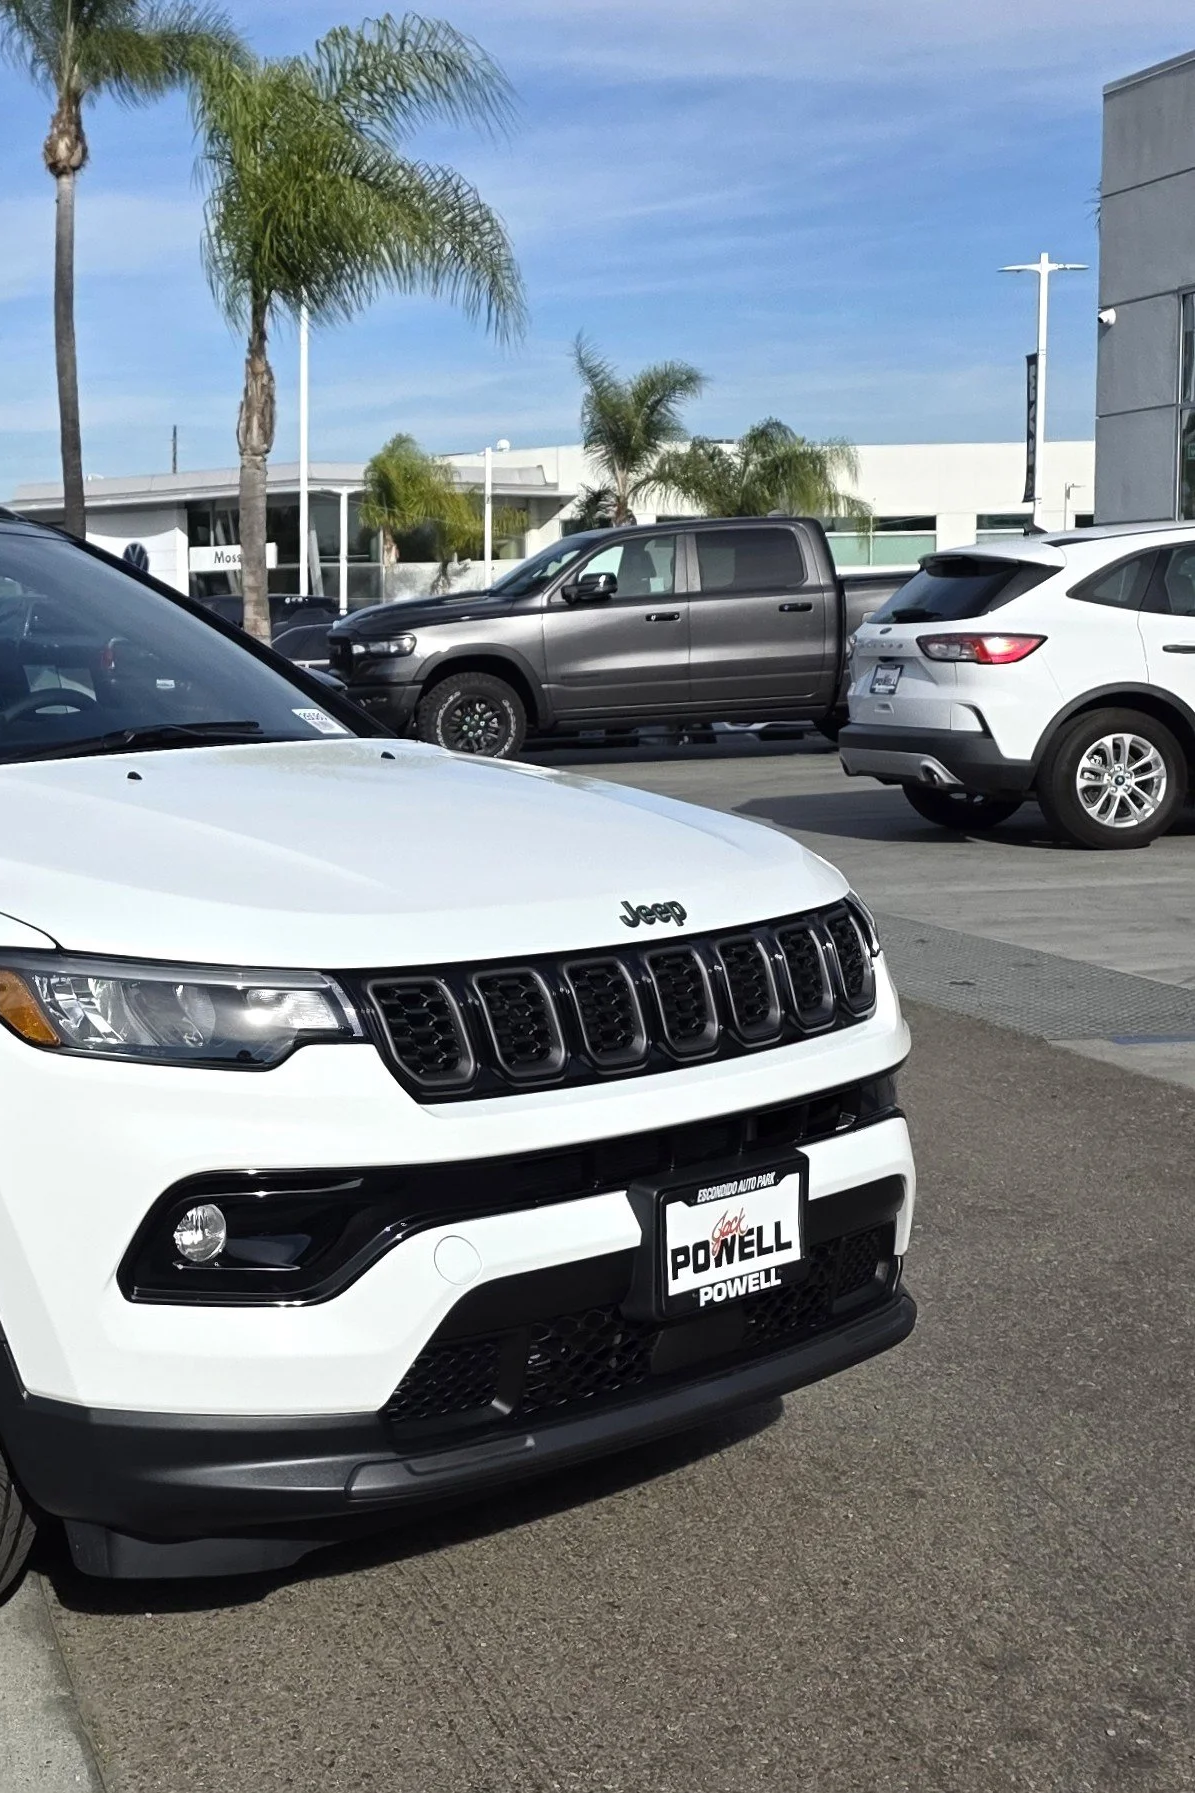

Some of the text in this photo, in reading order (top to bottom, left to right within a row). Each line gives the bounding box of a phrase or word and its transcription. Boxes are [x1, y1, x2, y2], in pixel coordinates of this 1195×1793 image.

[213, 551, 241, 564] Moss
[619, 900, 687, 928] Jeep
[697, 1171, 776, 1203] ESCONDIDO AUTO PARK
[711, 1207, 749, 1257] Jack
[670, 1220, 793, 1281] POWELL
[699, 1267, 782, 1308] POWELL
